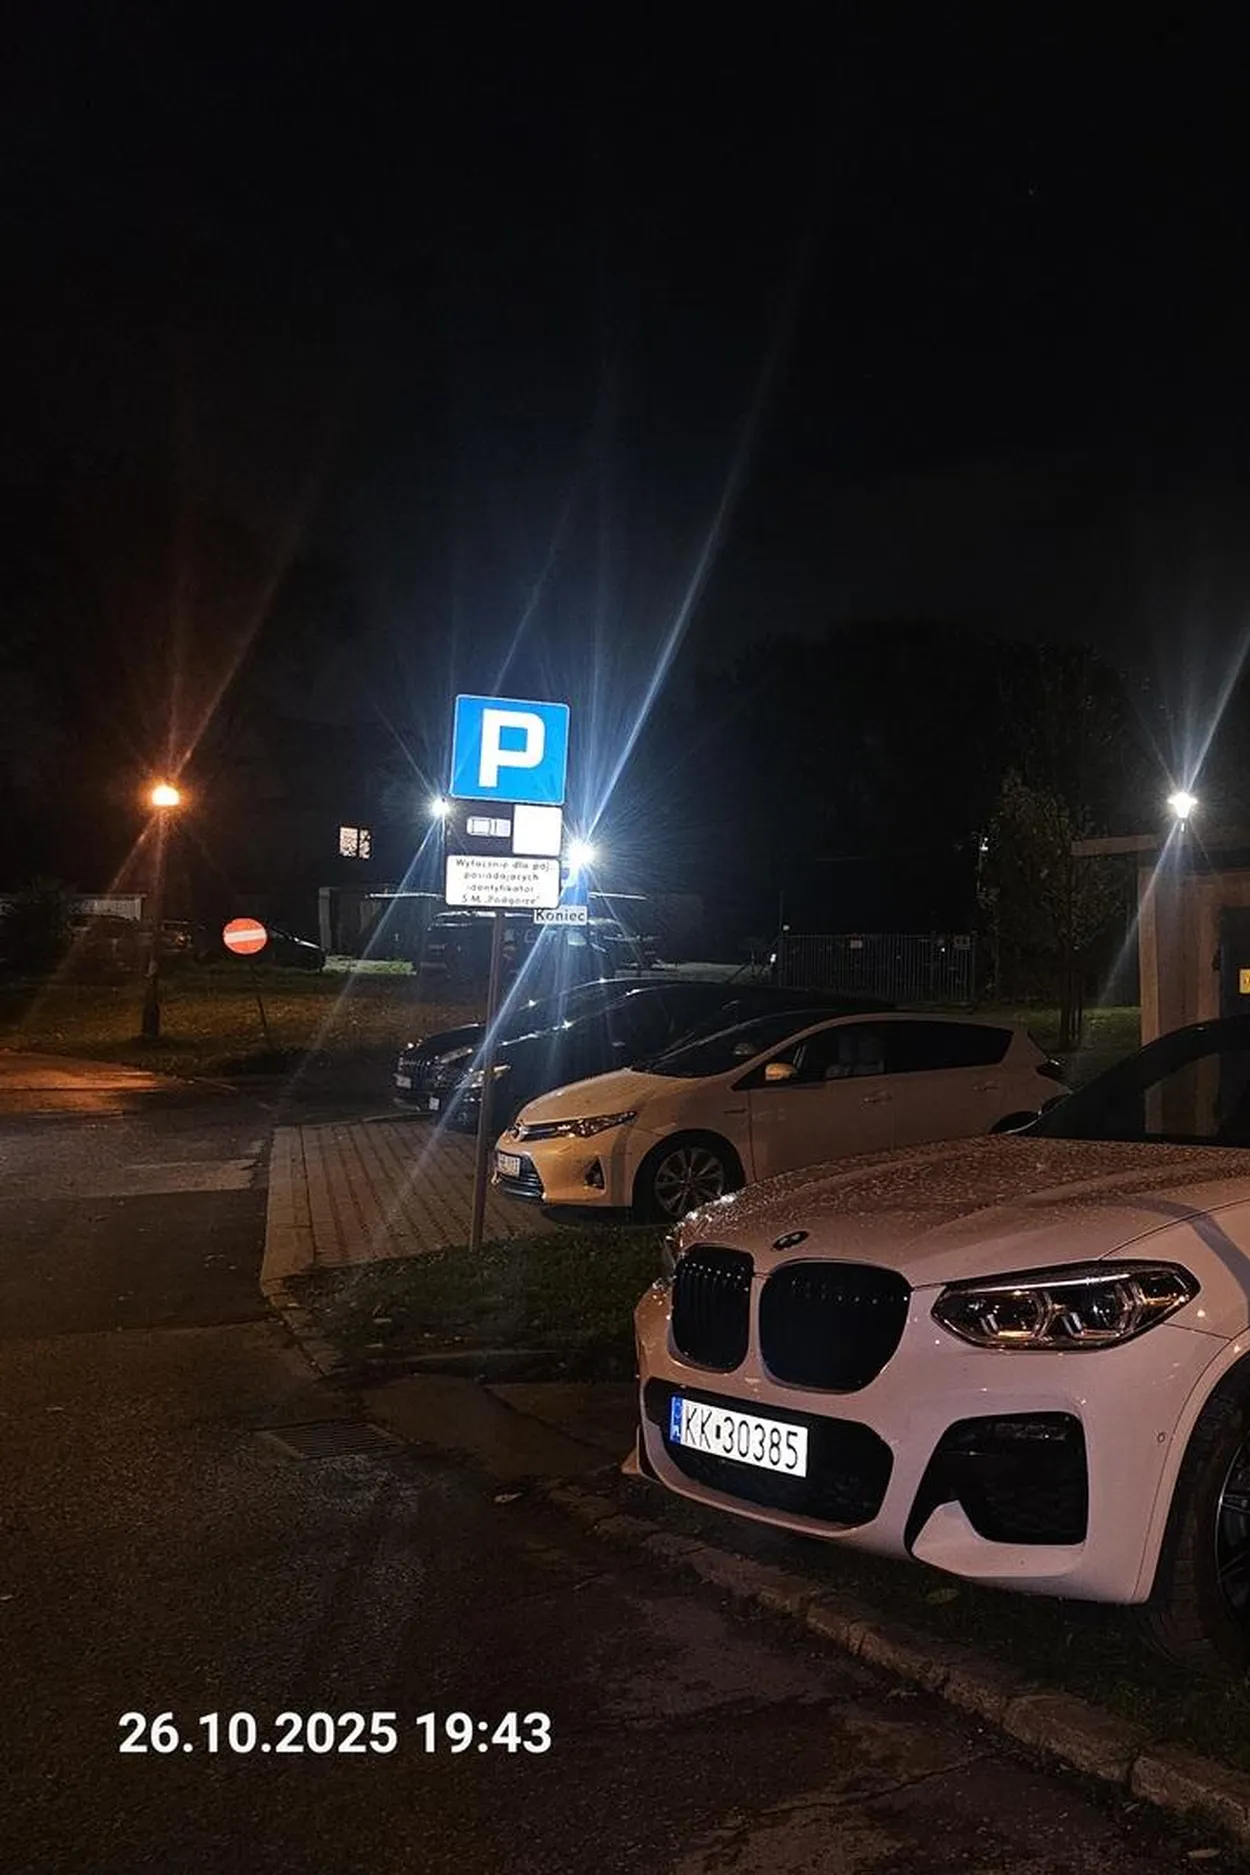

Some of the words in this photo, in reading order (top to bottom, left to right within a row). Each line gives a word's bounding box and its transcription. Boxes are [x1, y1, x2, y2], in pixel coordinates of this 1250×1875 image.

[478, 708, 546, 787] P
[536, 909, 585, 921] Koniec
[685, 1406, 712, 1449] KK
[722, 1417, 798, 1469] 30385
